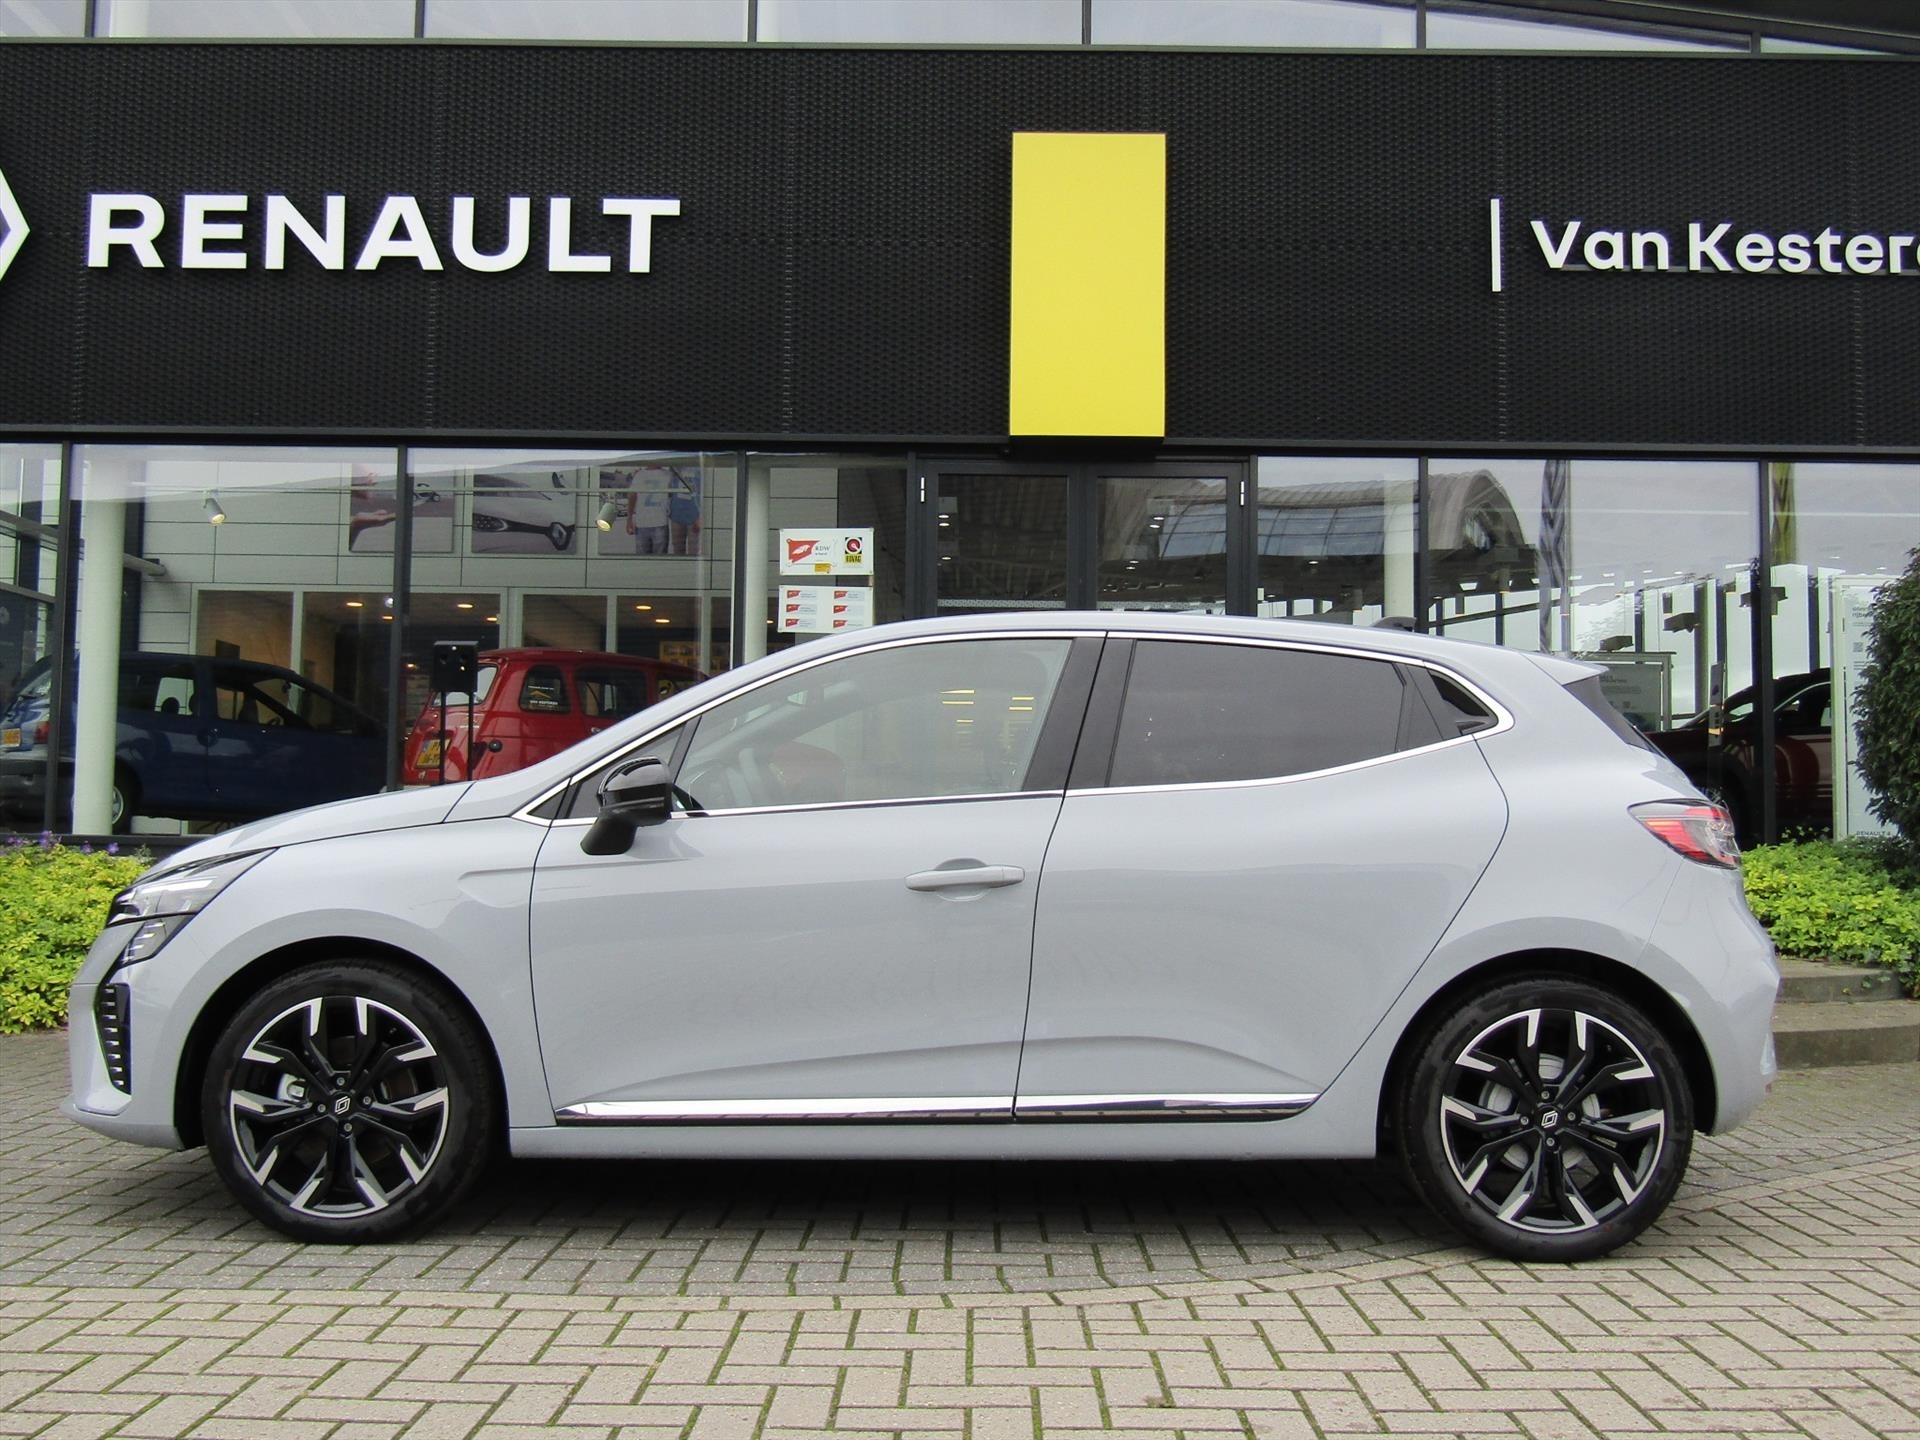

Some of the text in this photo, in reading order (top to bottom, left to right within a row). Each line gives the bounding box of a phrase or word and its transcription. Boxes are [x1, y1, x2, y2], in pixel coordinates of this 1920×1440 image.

[87, 193, 681, 273] RENAULT
[1530, 220, 1920, 274] Van Kester
